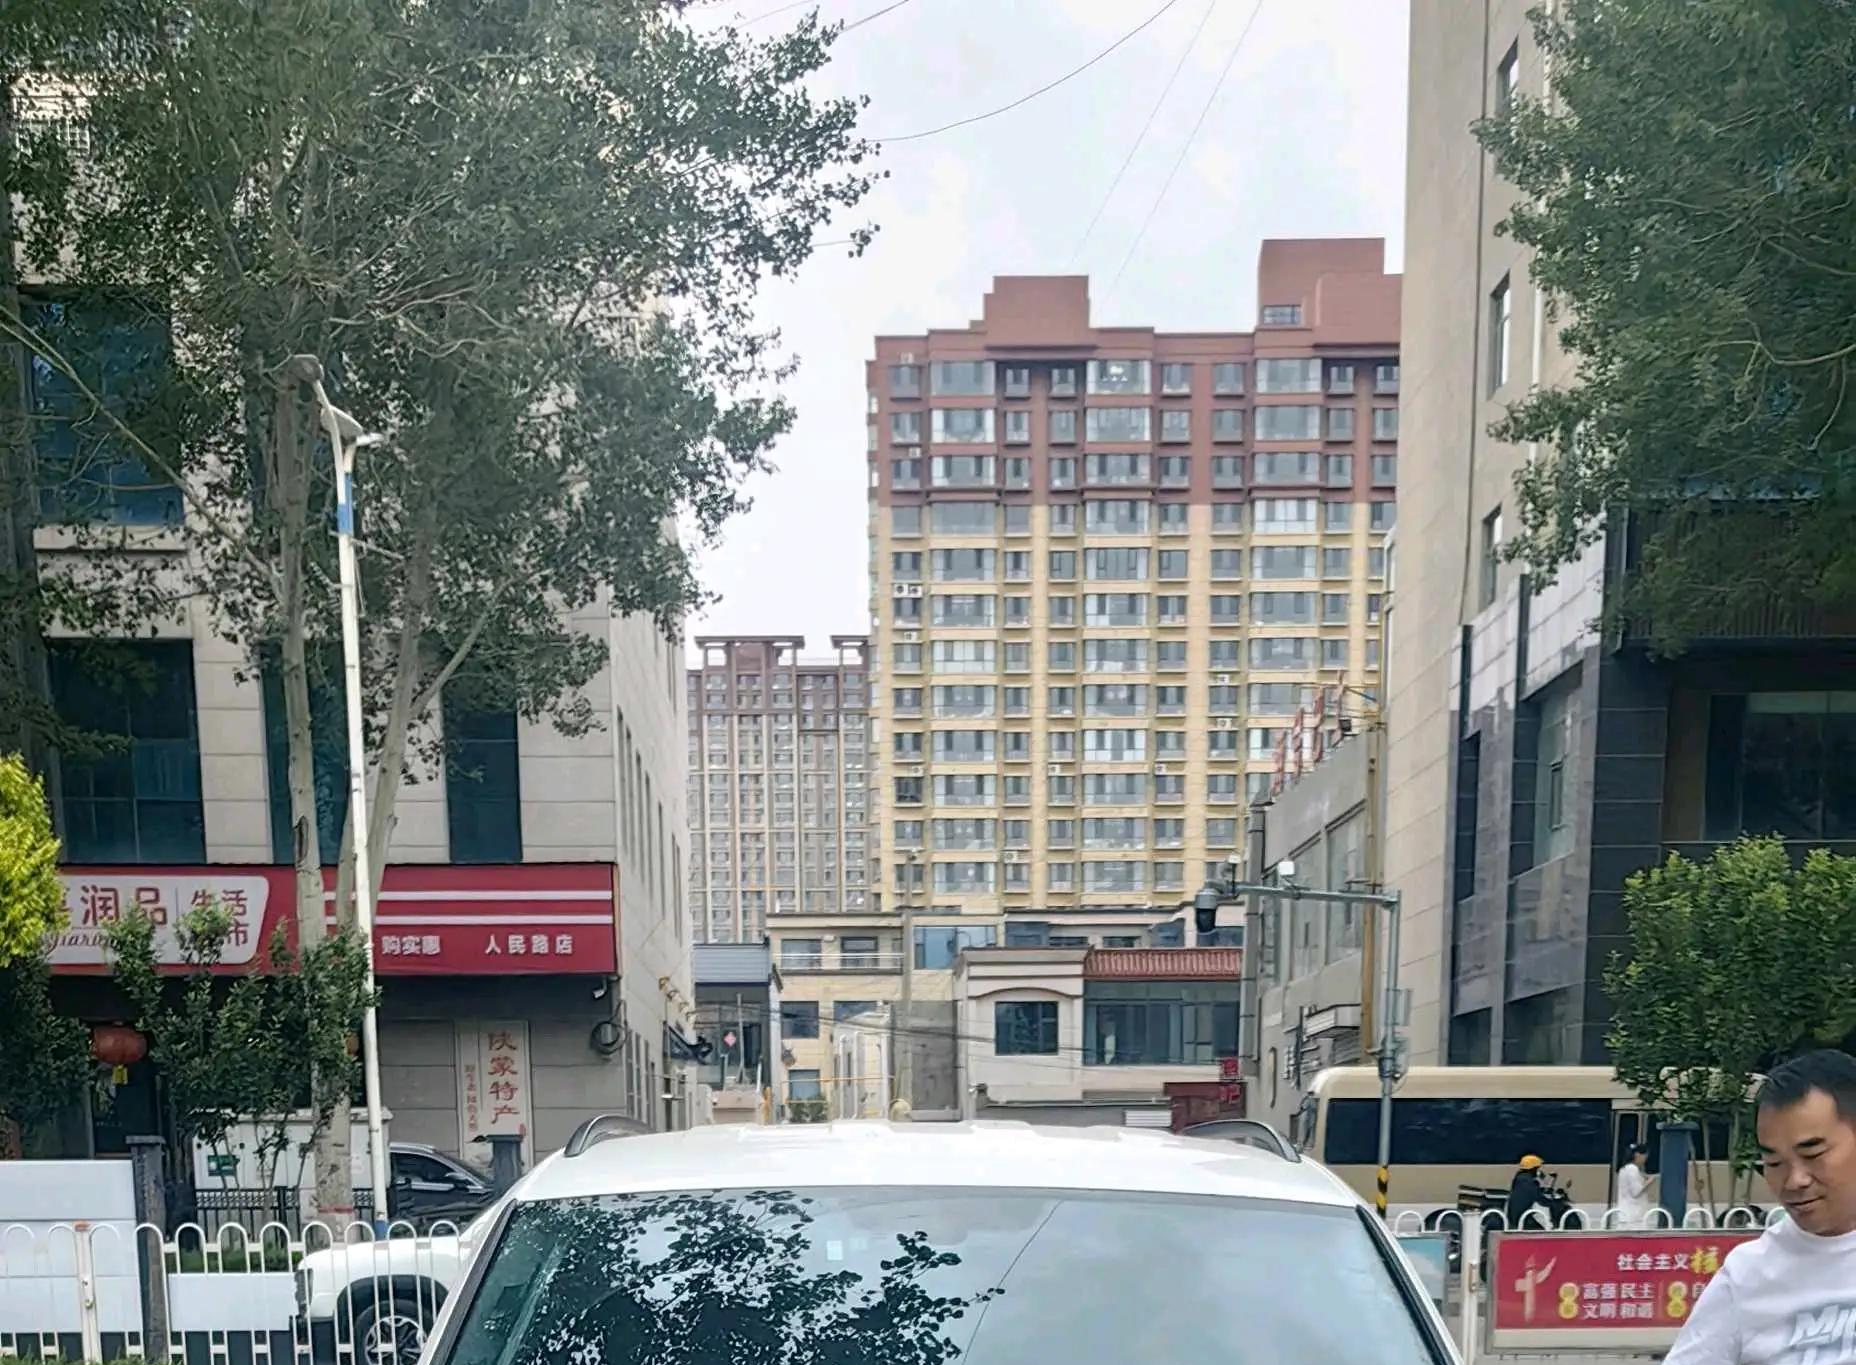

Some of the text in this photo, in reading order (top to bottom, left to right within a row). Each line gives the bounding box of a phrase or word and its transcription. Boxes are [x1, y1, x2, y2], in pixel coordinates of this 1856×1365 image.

[62, 885, 168, 926] 润品
[485, 934, 573, 954] 人民路店
[487, 1030, 520, 1125] 陕蒙特产
